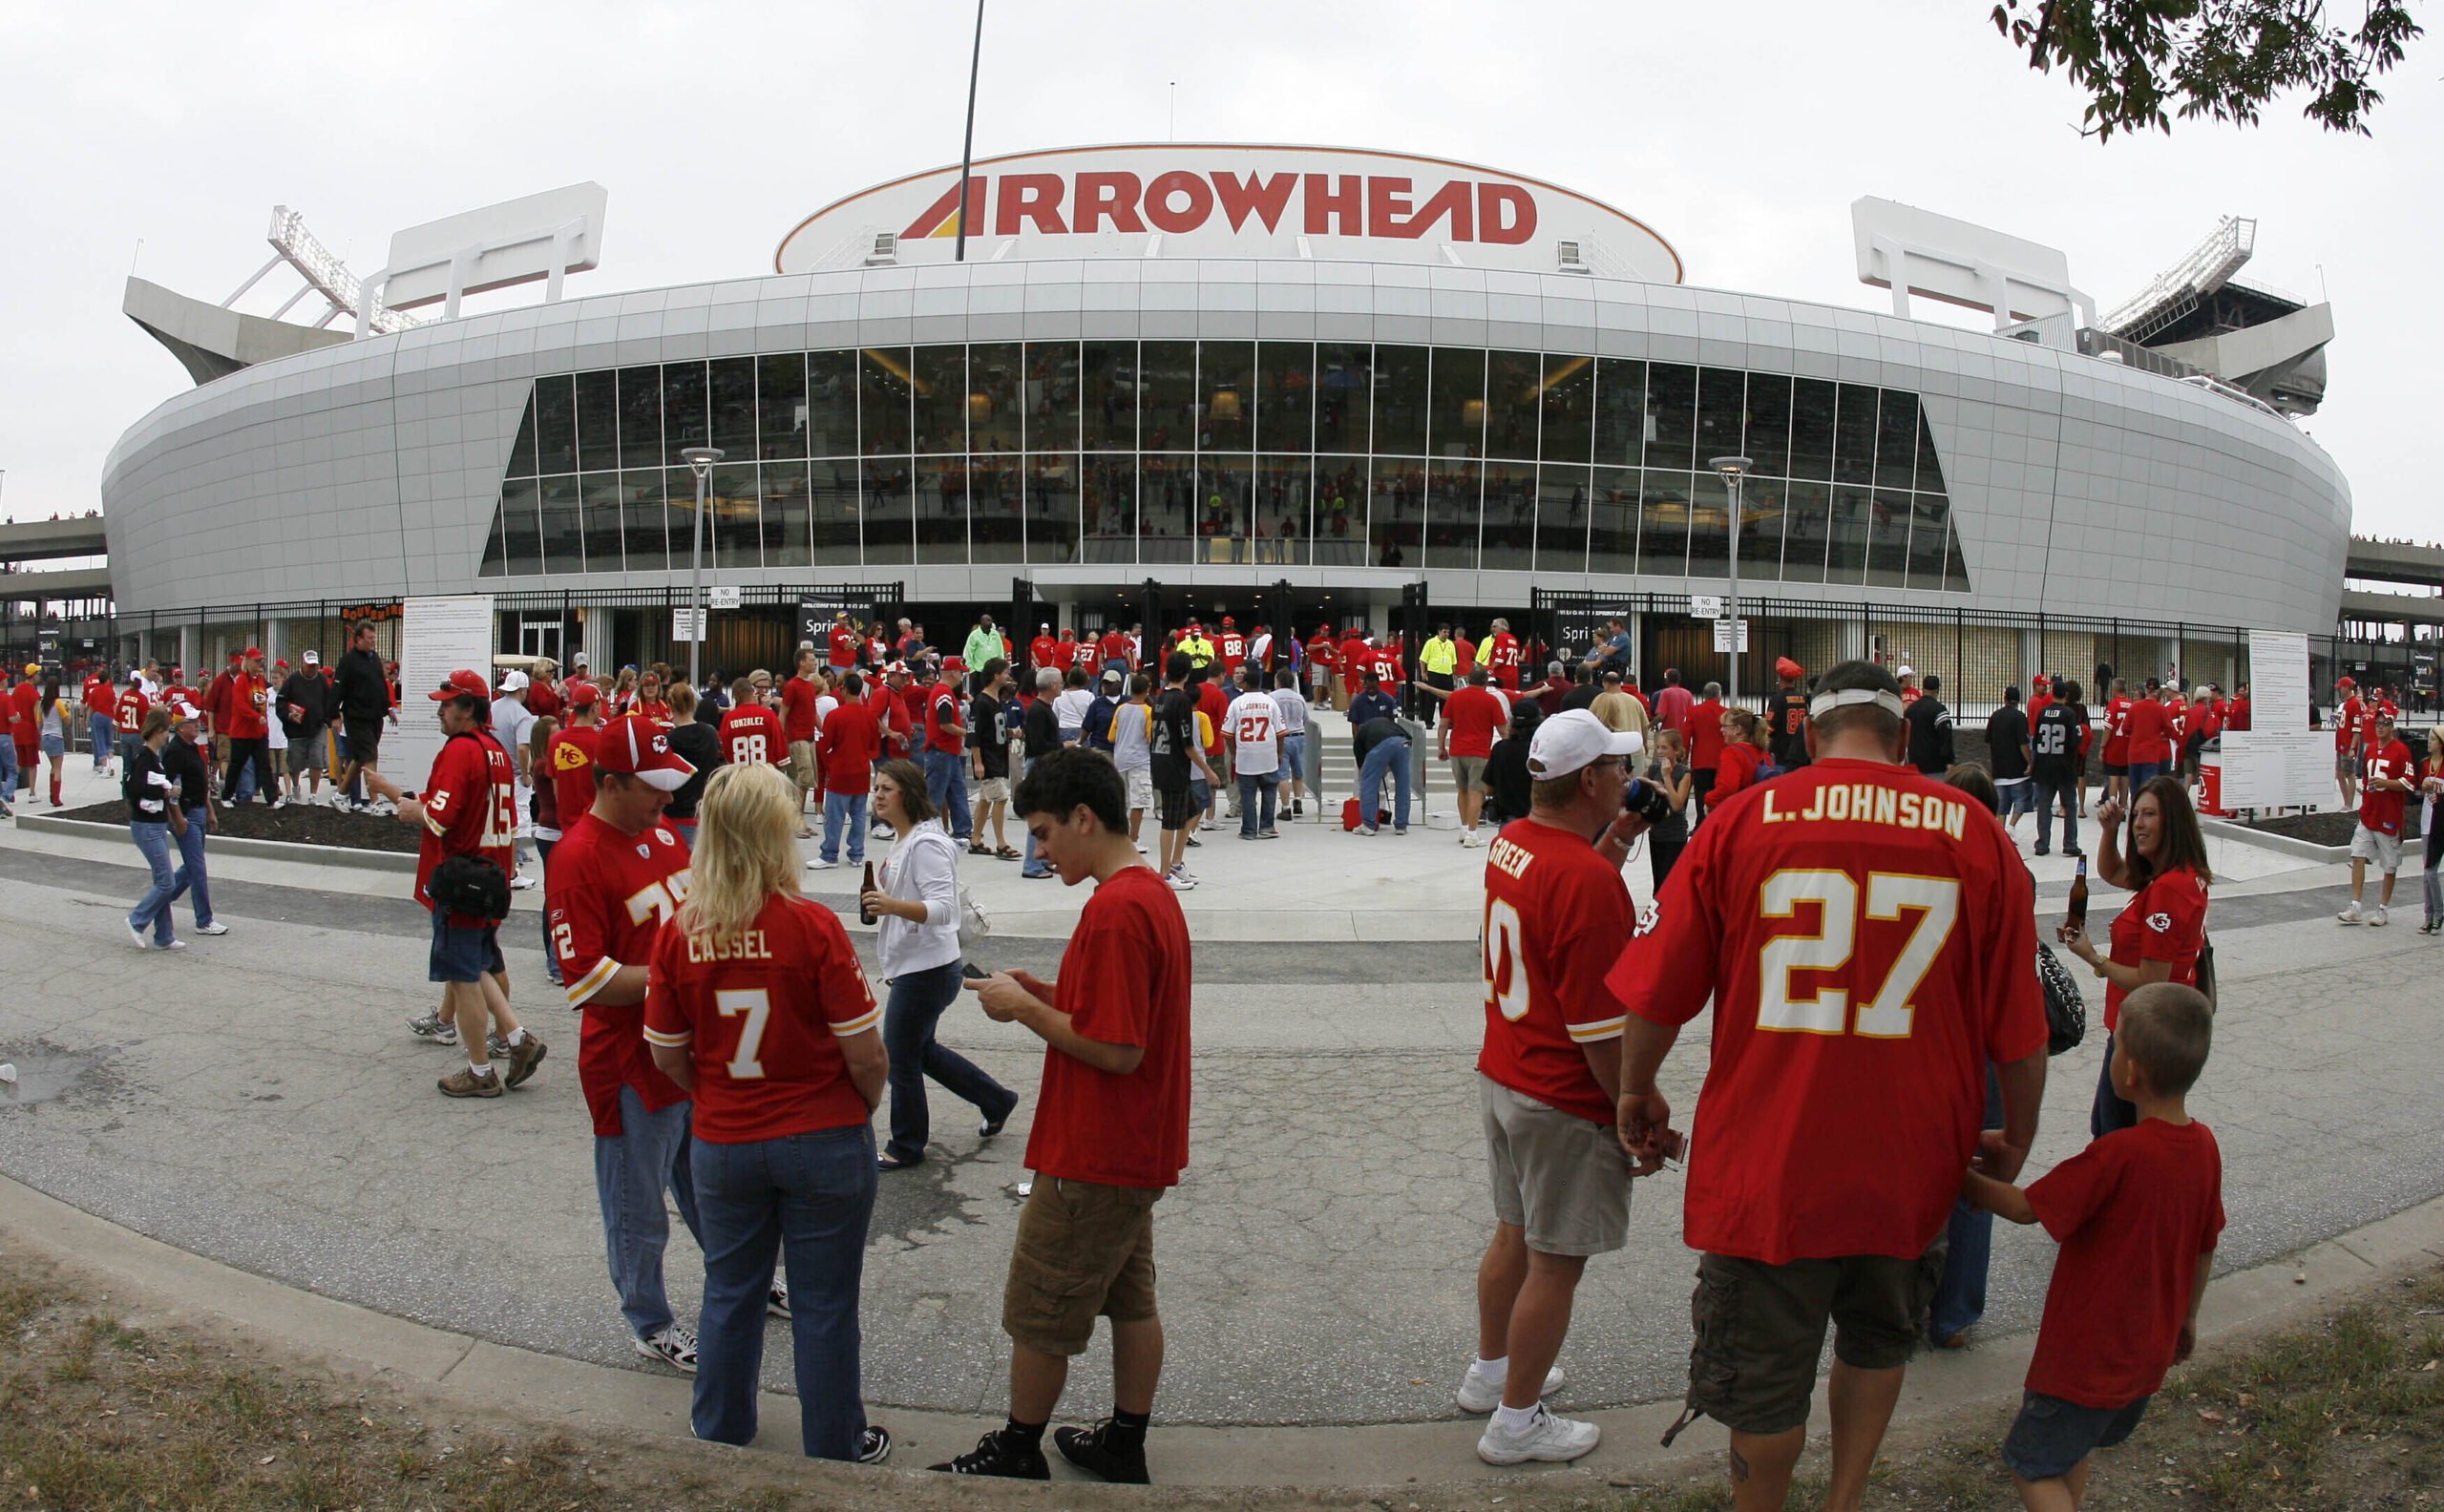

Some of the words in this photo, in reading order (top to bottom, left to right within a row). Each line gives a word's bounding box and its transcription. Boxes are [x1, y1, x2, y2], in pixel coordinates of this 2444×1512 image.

[897, 169, 1538, 245] ARROWHEAD
[711, 598, 740, 606] RE-ENTRY
[720, 588, 730, 597] NO
[1691, 607, 1719, 617] RE-ENTRY
[806, 619, 838, 637] Sprin
[1563, 625, 1601, 643] Spri
[1081, 648, 1095, 662] 27
[1225, 640, 1243, 657] 88
[1375, 661, 1395, 682] 91
[122, 704, 139, 730] 31
[730, 716, 765, 729] GONZALEZ
[2044, 709, 2061, 719] ALLEN
[994, 710, 1008, 746] 8
[1181, 724, 1191, 738] 12
[1240, 716, 1270, 742] 27
[2036, 723, 2066, 755] 32
[732, 734, 768, 766] 88
[2366, 758, 2391, 792] 15
[2404, 761, 2414, 777] 15
[428, 789, 451, 811] 5
[479, 783, 512, 848] 15
[1762, 783, 1968, 841] L.JOHNSON
[1488, 836, 1534, 880] GREEN
[1755, 868, 1962, 1040] 27
[715, 988, 770, 1080] 7
